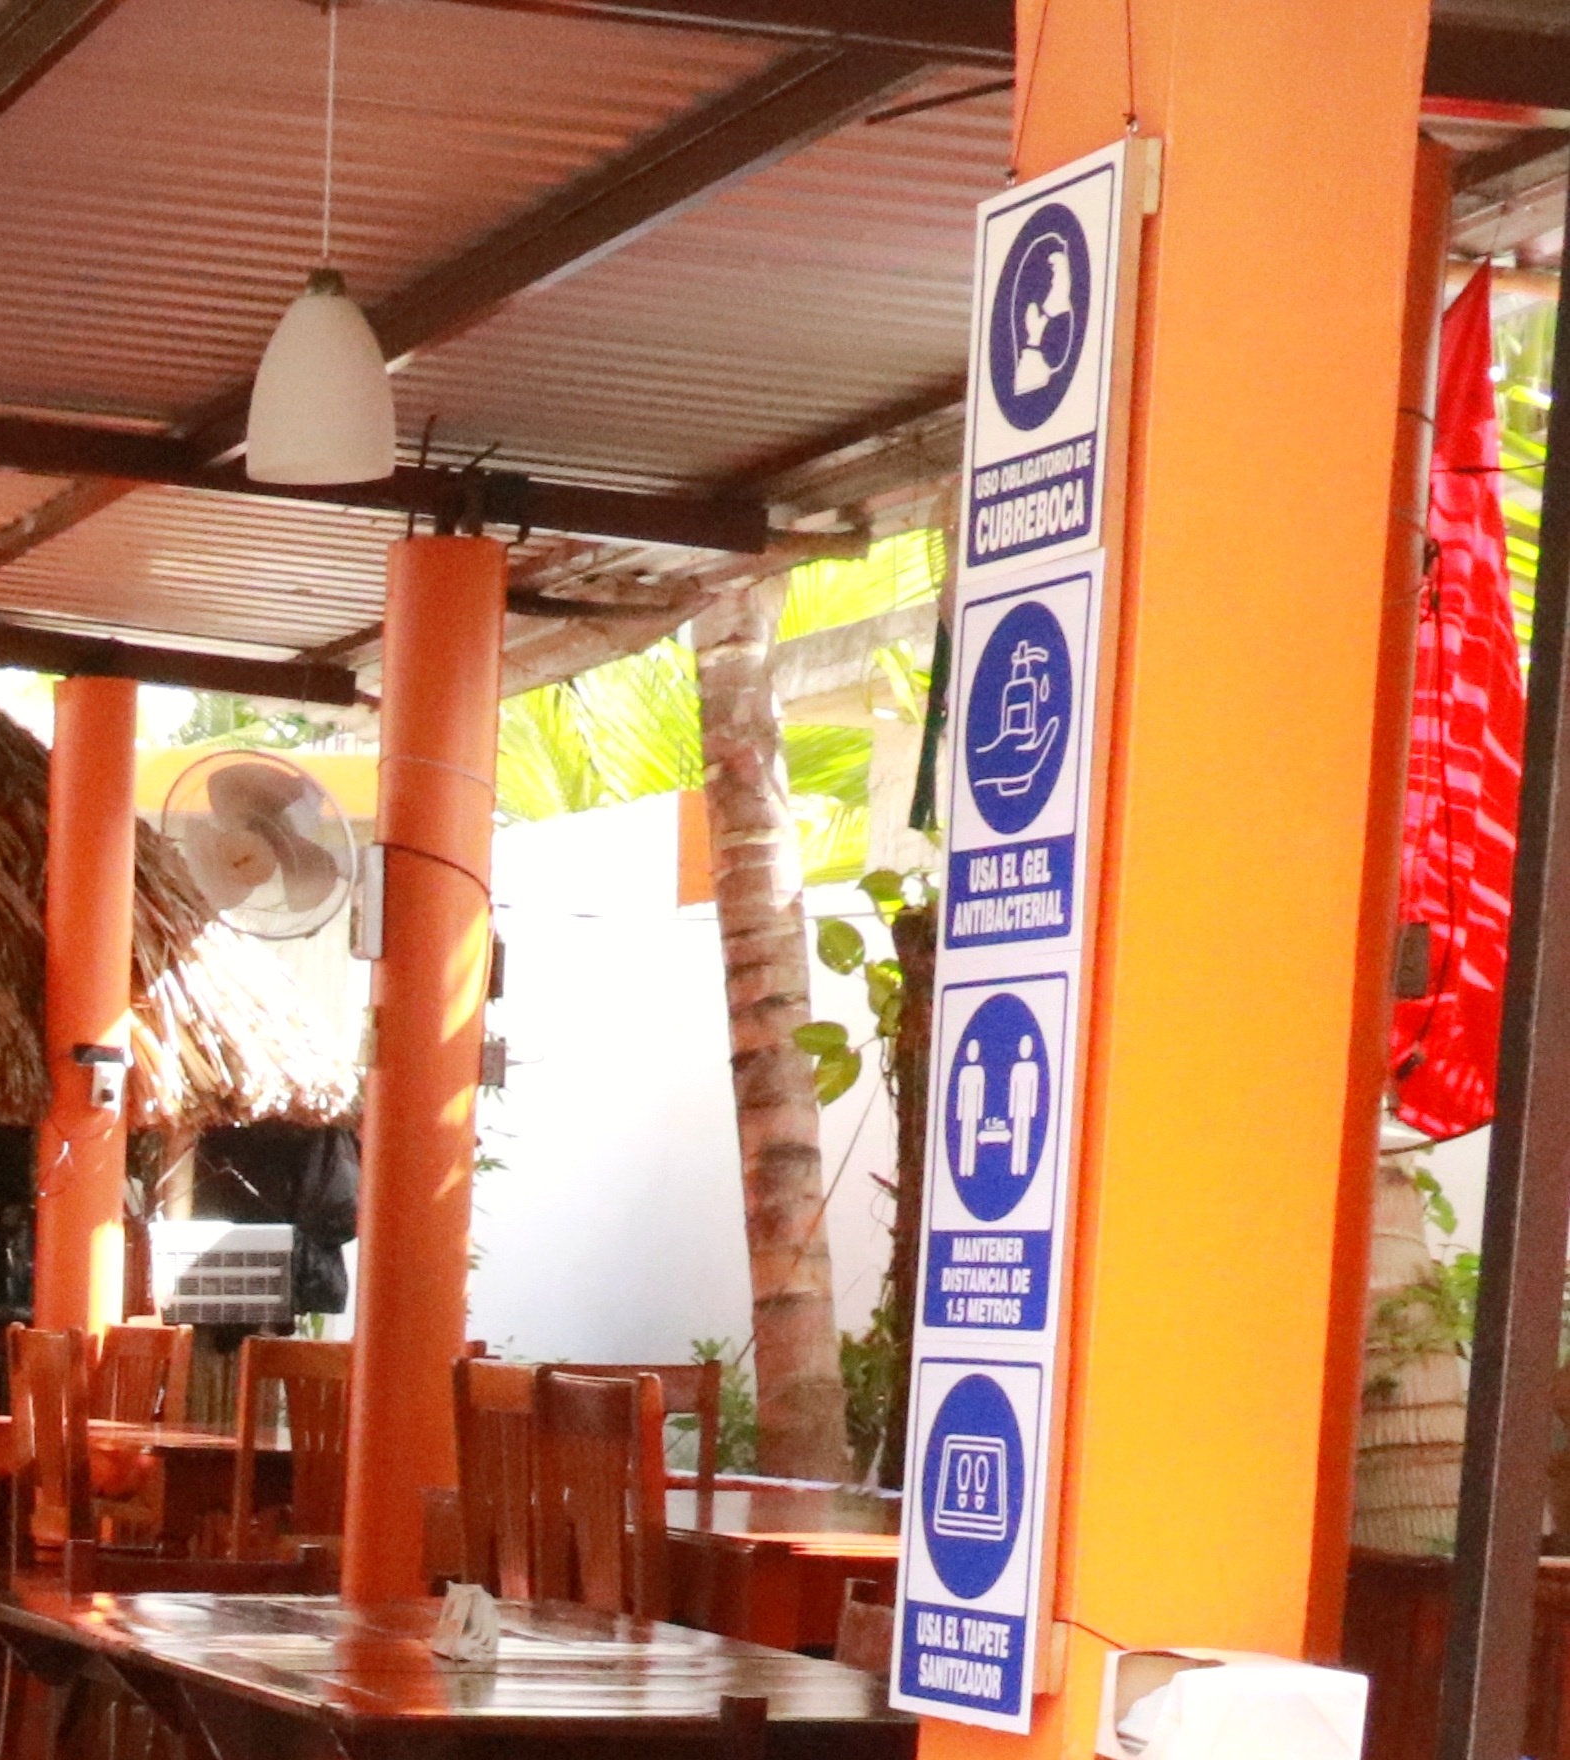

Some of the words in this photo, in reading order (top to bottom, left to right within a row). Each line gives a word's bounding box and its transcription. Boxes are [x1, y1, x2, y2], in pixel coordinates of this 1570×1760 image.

[975, 469, 999, 500] USO
[1001, 445, 1074, 493] OBLIGATORIO
[1075, 440, 1092, 469] DE
[975, 478, 1085, 555] CUBREBOCA
[969, 855, 1000, 894] USA
[1001, 853, 1019, 889] EL
[1022, 847, 1052, 885] GEL
[952, 889, 1065, 938] ANTIBACTERIAL
[951, 1236, 1024, 1264] MANTENER
[940, 1267, 1008, 1294] DISTANCIA
[1010, 1268, 1031, 1295] DE
[944, 1296, 964, 1323] 1.5
[966, 1297, 1022, 1325] METROS
[917, 1610, 943, 1647] USA
[943, 1615, 960, 1650] EL
[961, 1619, 1010, 1660] TAPETE
[917, 1652, 1003, 1701] SANITIZADOR
